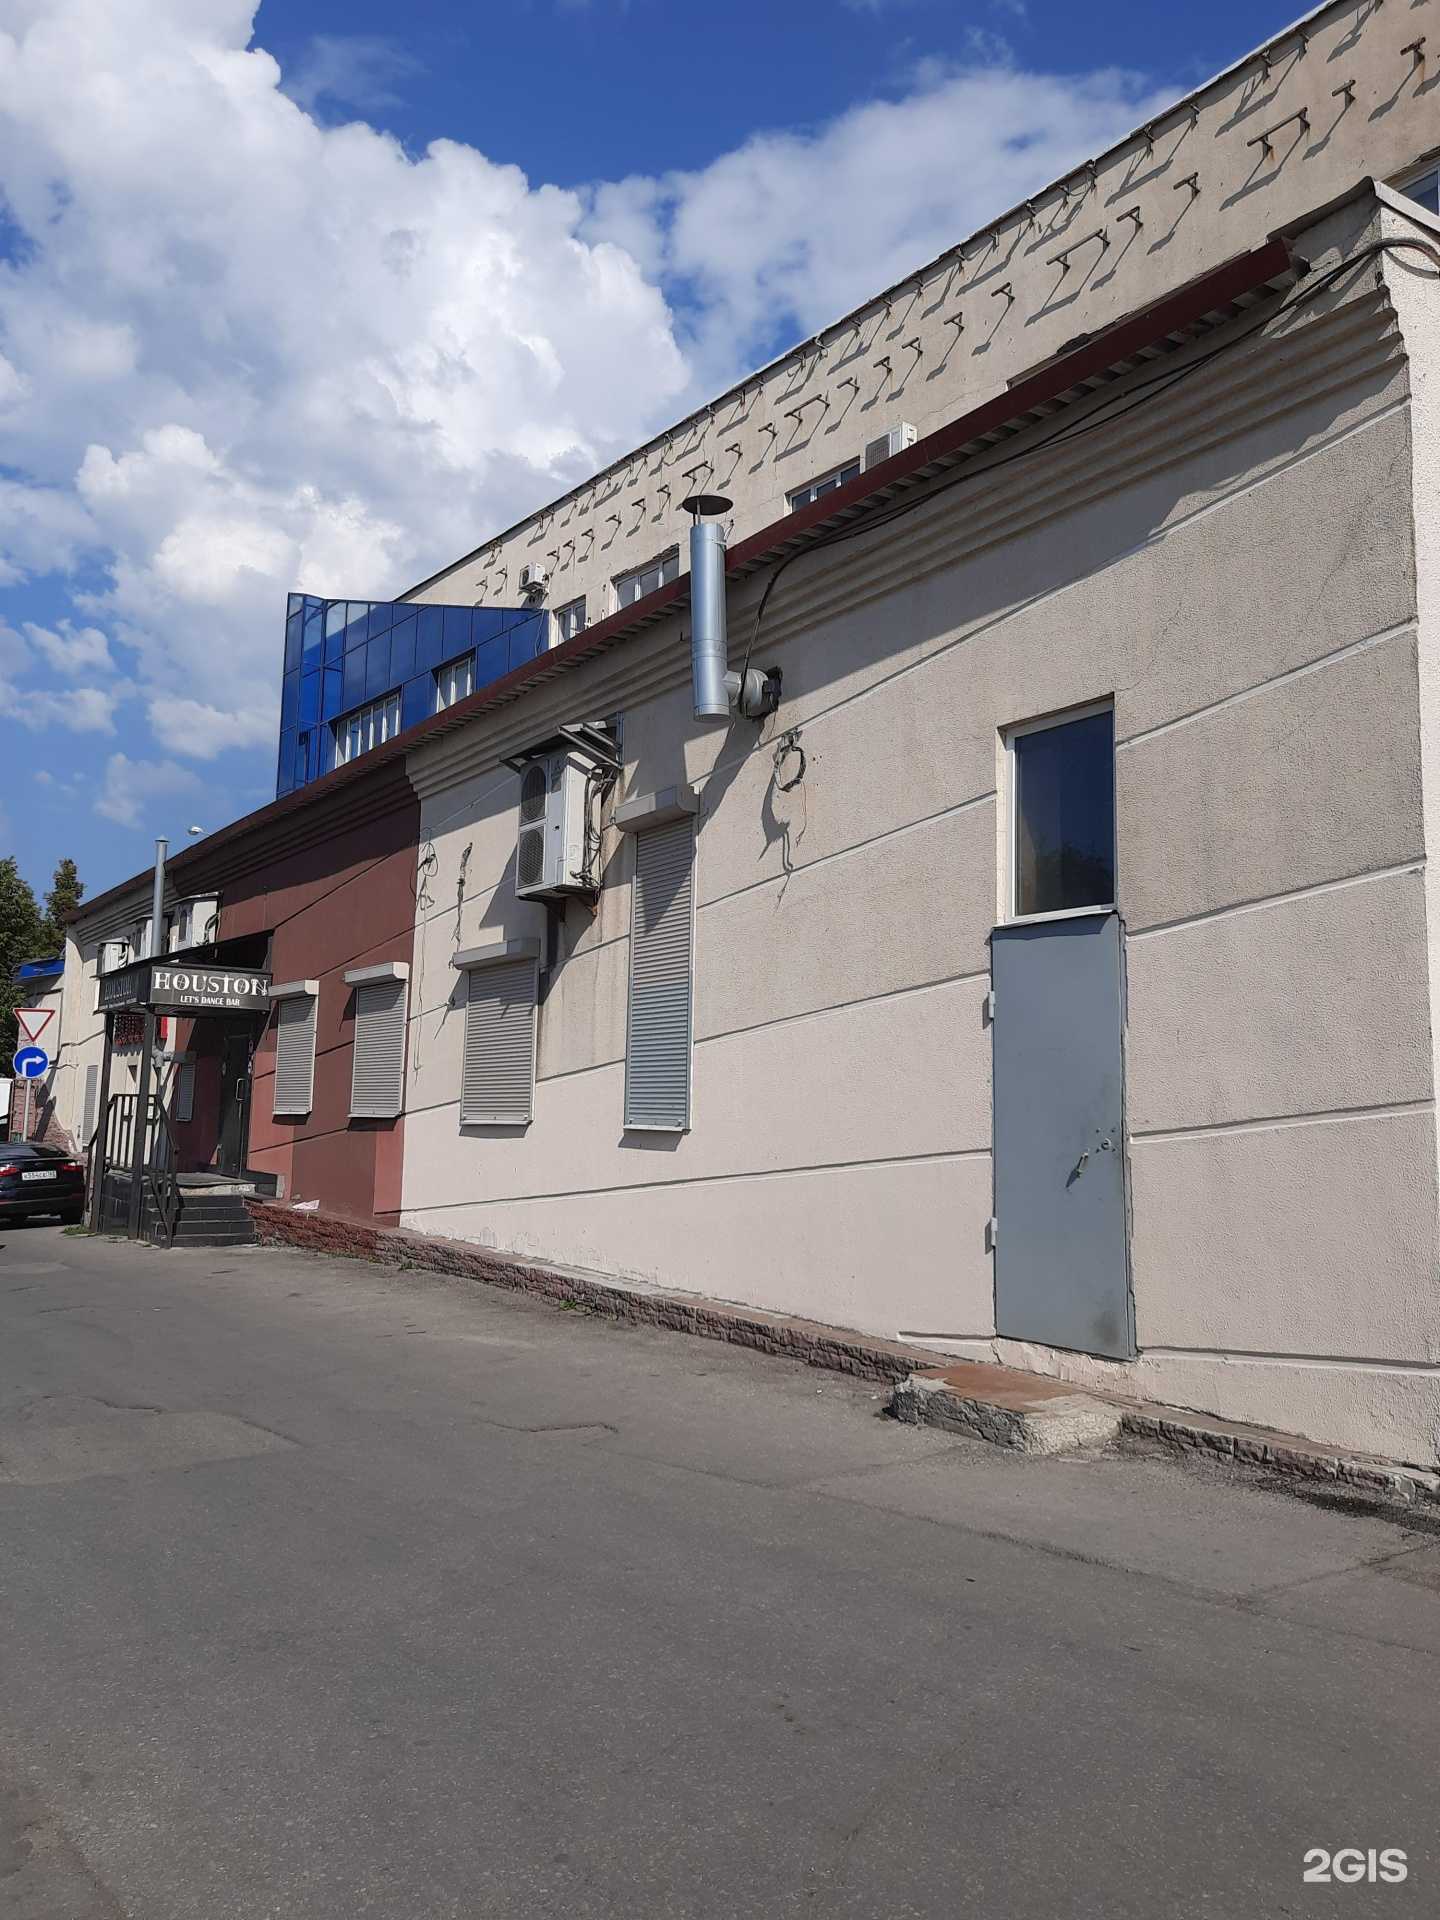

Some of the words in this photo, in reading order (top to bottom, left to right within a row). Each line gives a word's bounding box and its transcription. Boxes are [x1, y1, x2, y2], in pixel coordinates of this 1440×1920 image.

[153, 972, 268, 996] HOUSTON
[180, 995, 200, 1004] LET'S
[201, 996, 225, 1006] DANCE
[226, 998, 241, 1007] BAR
